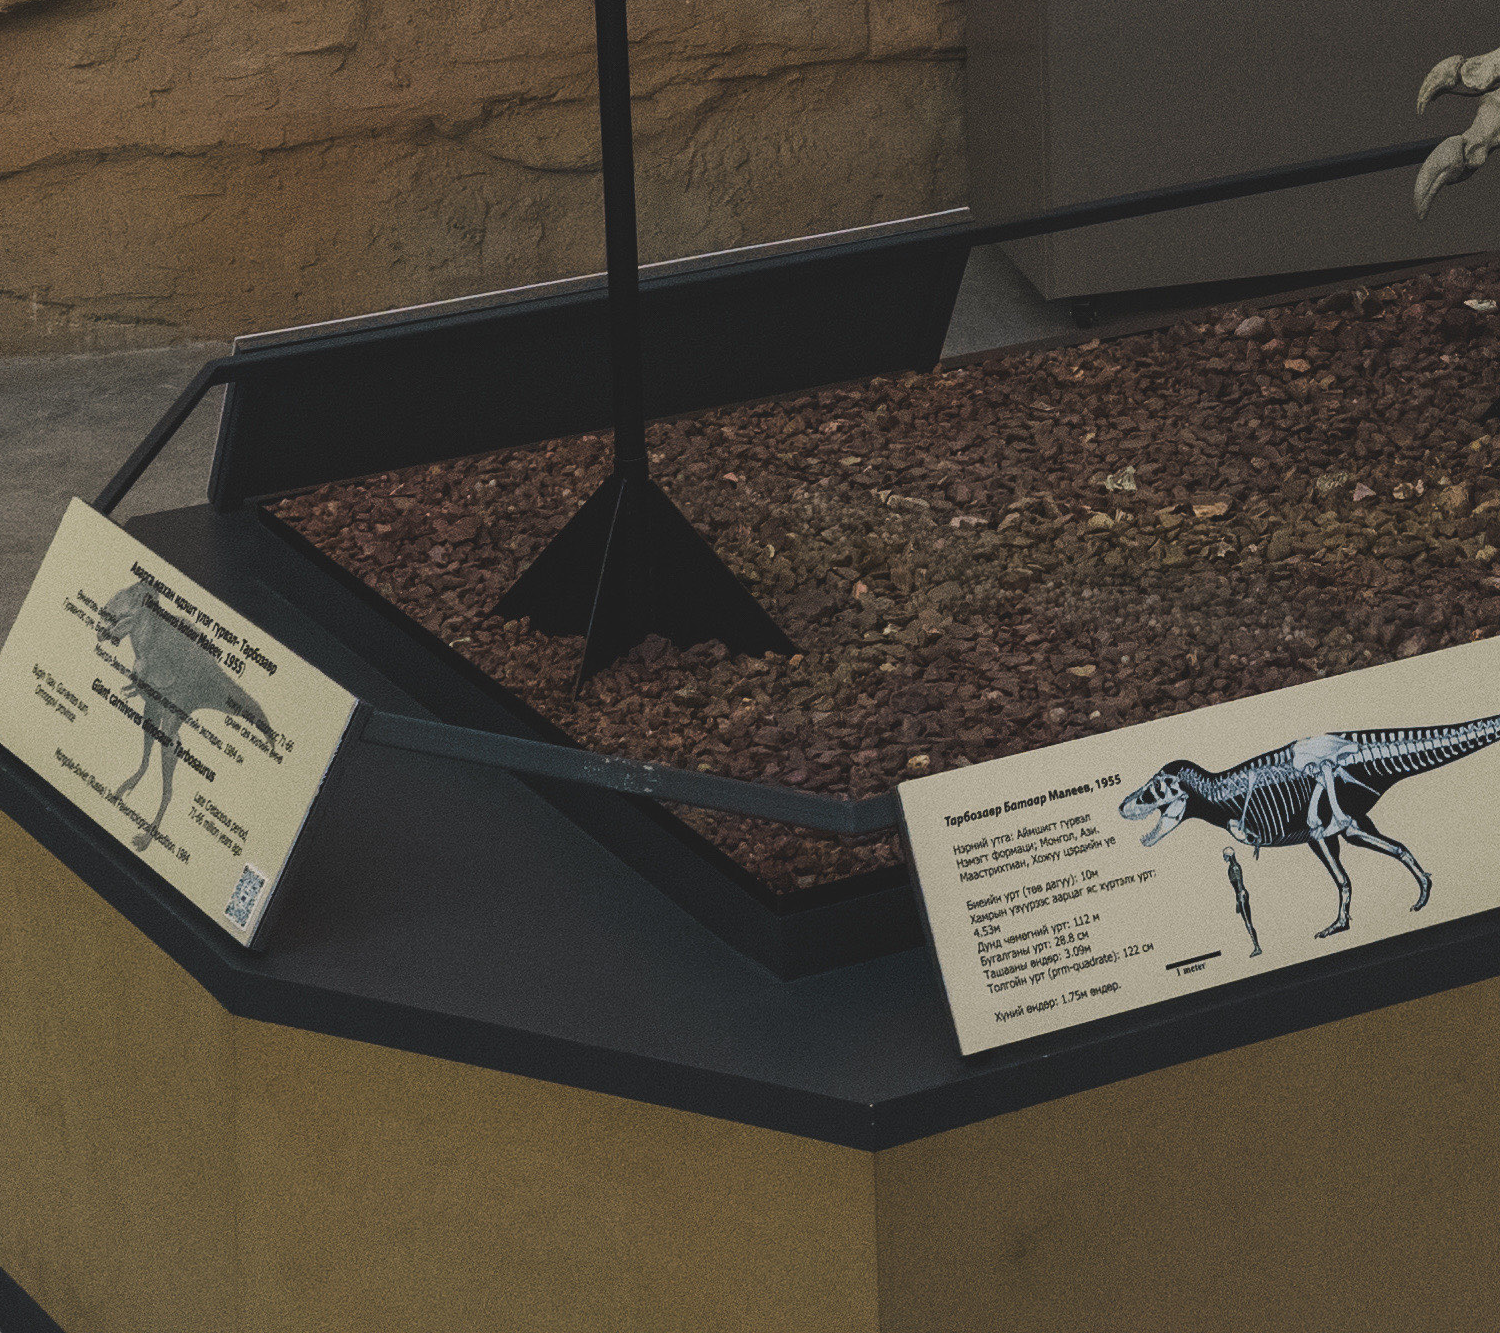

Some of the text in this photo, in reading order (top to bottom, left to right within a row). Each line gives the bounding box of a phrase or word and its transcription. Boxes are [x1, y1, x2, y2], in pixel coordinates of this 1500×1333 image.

[129, 561, 155, 589] Аварга
[239, 638, 277, 676] Тарбозавр
[223, 652, 246, 678] 1955)
[91, 677, 111, 700] Giant
[108, 693, 145, 726] carnivores
[172, 739, 216, 782] Tarbosaurus
[944, 805, 1002, 827] Тарбозавр
[1047, 783, 1094, 801] Малеев,
[1094, 773, 1121, 789] 1955
[952, 837, 989, 855] Нэрний
[989, 833, 1013, 848] утга:
[1038, 831, 1078, 847] Монгол,
[965, 894, 1002, 911] Биеийн
[1003, 889, 1020, 903] урт
[1080, 869, 1098, 881] 10м
[969, 908, 1007, 925] Хамрын
[1136, 869, 1156, 883] урт:
[973, 924, 1001, 937] 4.53м
[977, 938, 1003, 954] Дунд
[1050, 920, 1071, 935] урт:
[1072, 913, 1091, 927] 112
[1031, 940, 1052, 955] урт:
[1053, 932, 1075, 947] 28.8
[1076, 930, 1089, 941] см
[982, 961, 1028, 979] Ташааны
[1063, 944, 1092, 959] 3.09м
[986, 942, 1154, 993] Толгойн урт (prm-quadrate): 122 см
[1182, 962, 1205, 975] meter
[993, 1004, 1024, 1022] Хүний
[1060, 989, 1088, 1004] 1.75м
